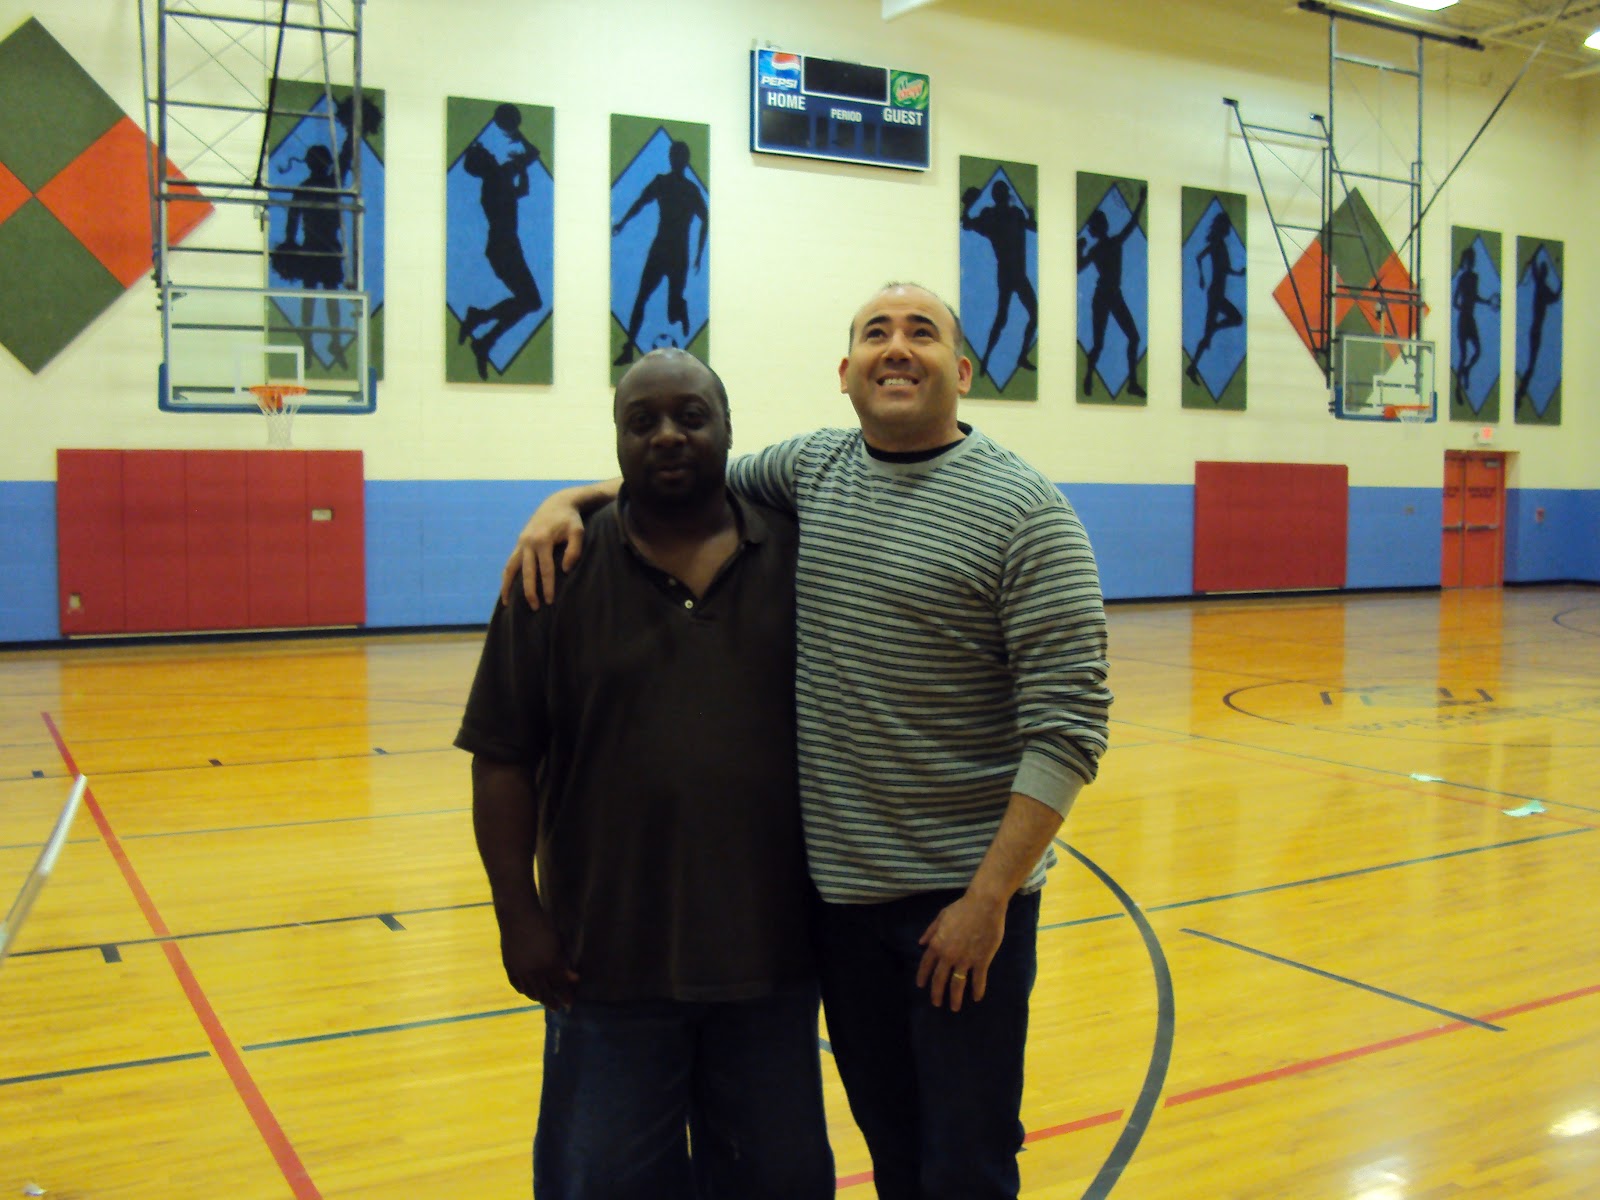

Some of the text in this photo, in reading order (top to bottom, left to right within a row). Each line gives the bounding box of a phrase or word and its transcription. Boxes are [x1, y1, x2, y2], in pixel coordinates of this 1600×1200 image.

[761, 75, 797, 89] PEPSI
[767, 92, 806, 110] HOME
[831, 109, 862, 122] PERIOD
[883, 108, 923, 126] GUEST
